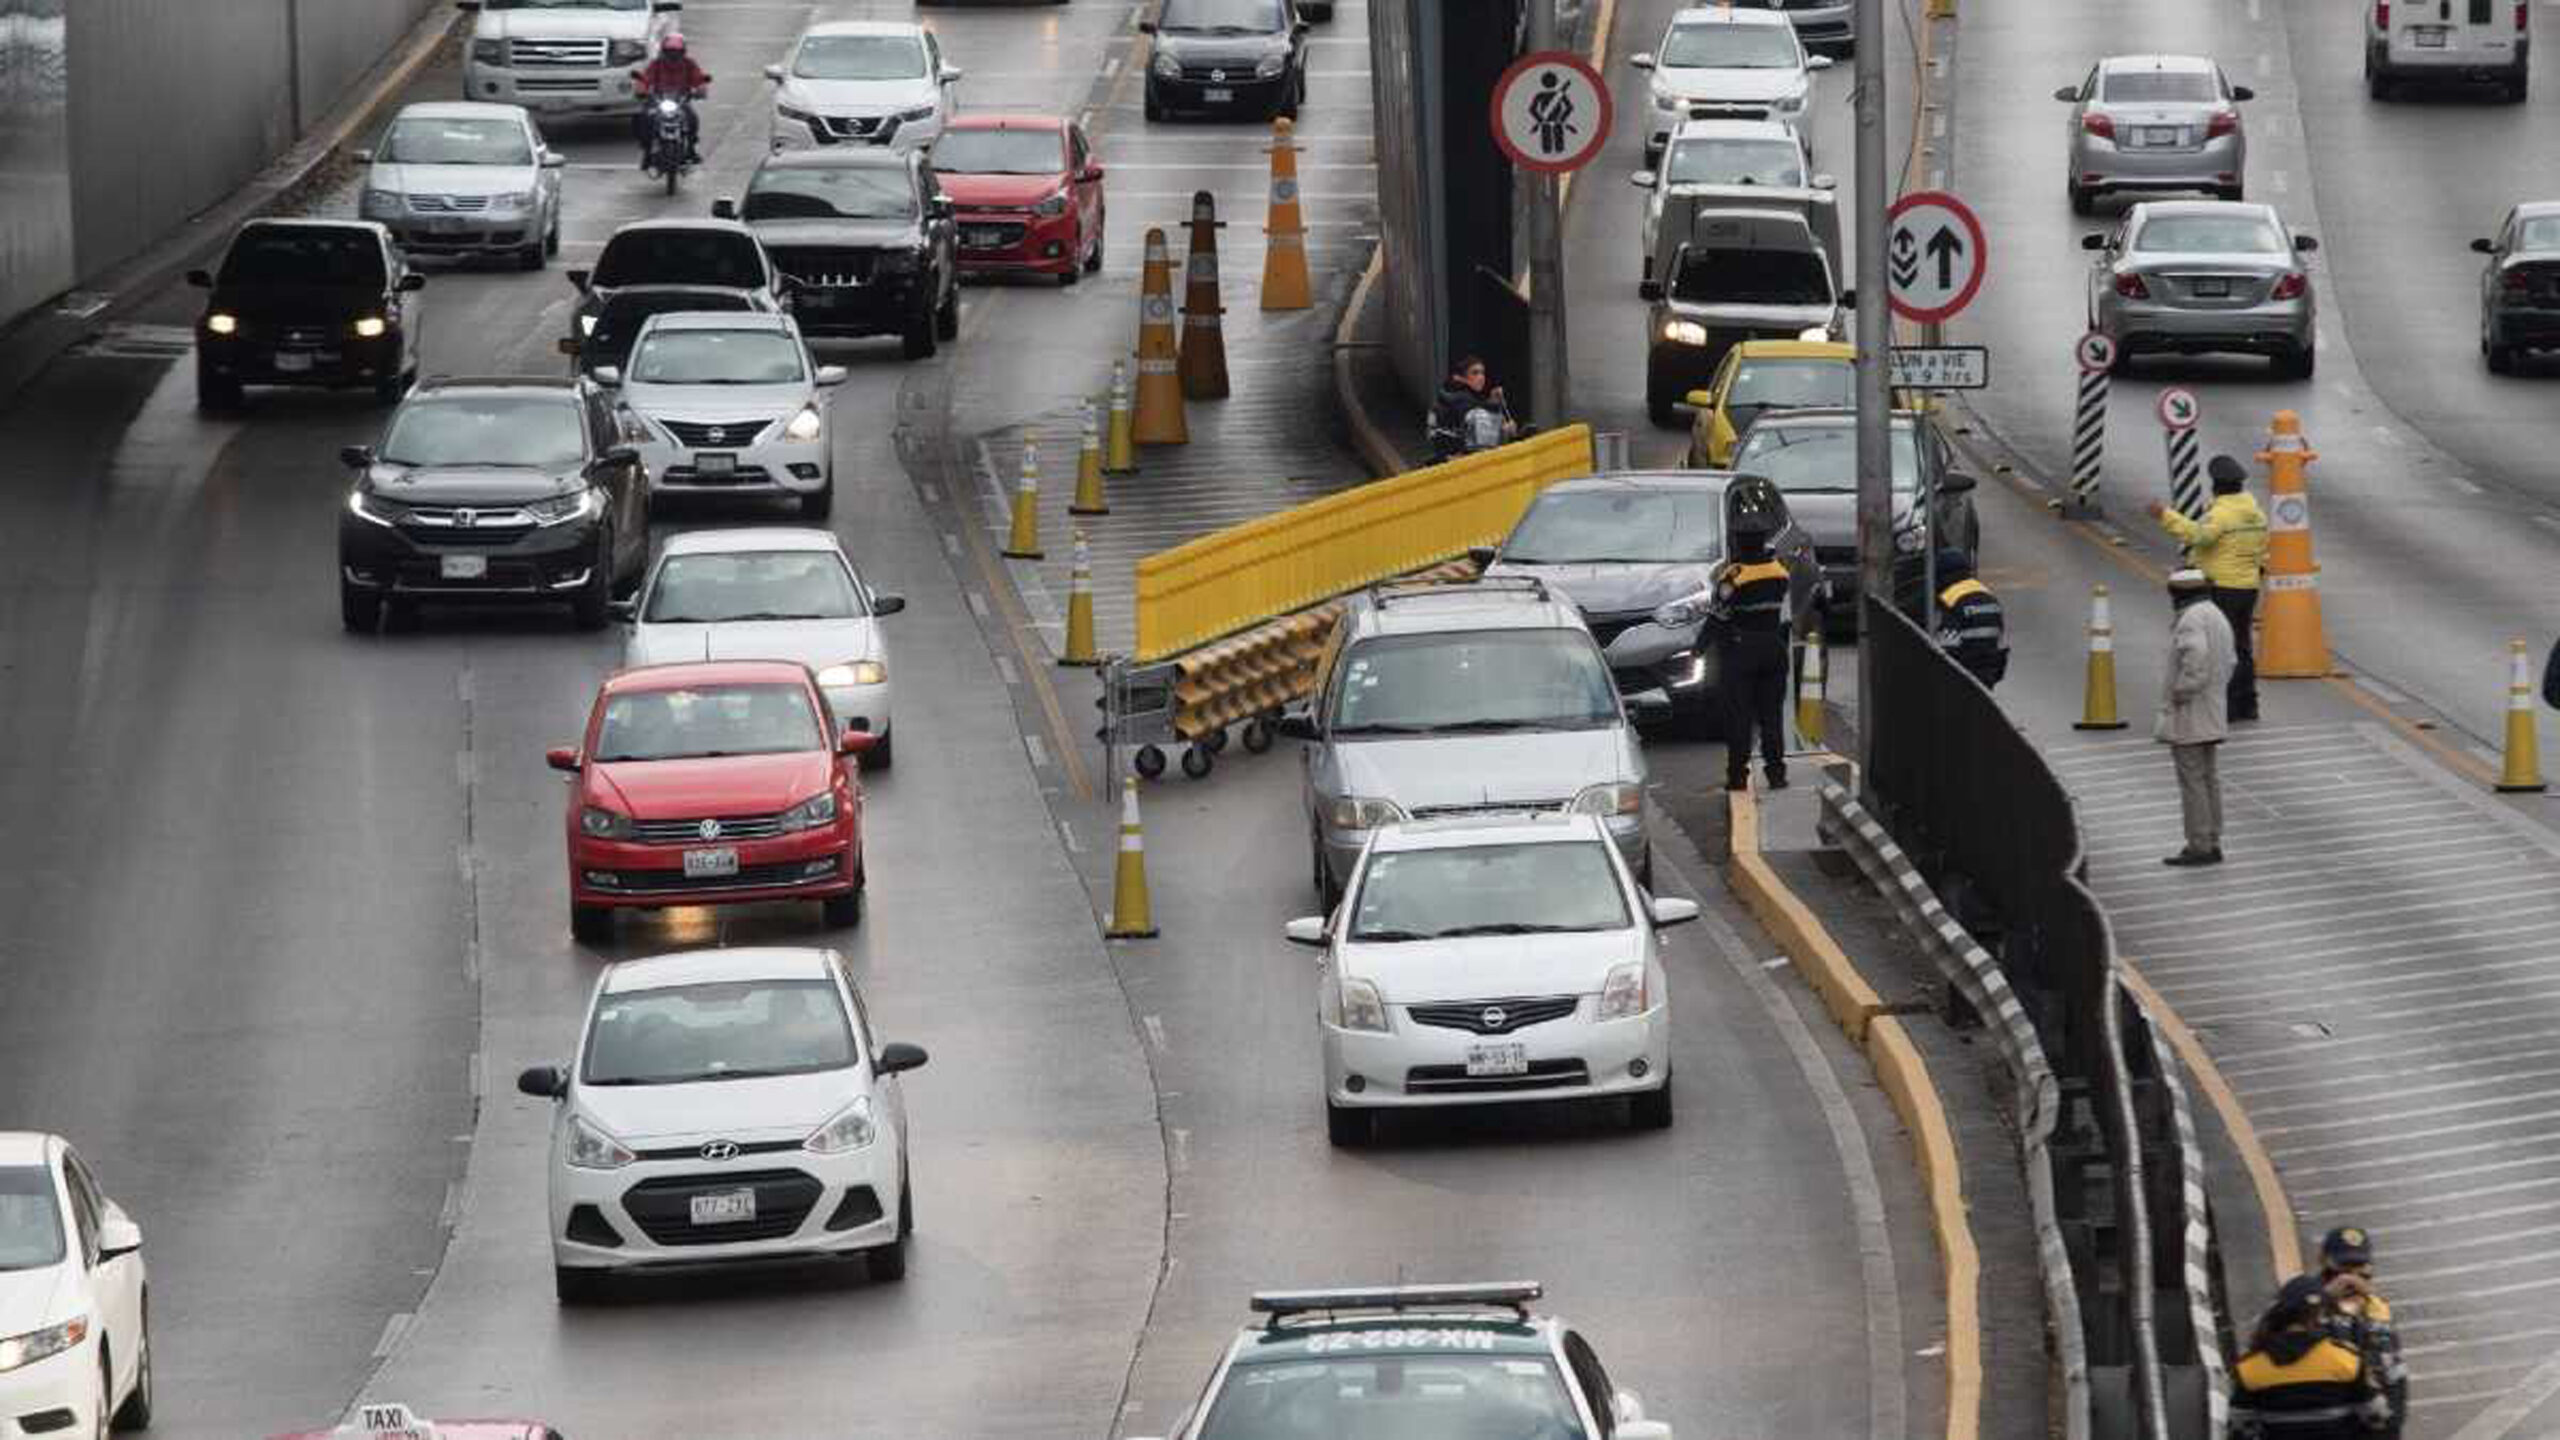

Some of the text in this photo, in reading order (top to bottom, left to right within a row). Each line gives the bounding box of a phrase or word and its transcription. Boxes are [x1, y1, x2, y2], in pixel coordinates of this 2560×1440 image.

[1928, 355, 1937, 368] a
[1943, 353, 1966, 368] VIE
[1923, 369, 1932, 383] 9
[1942, 371, 1972, 383] hrs
[364, 1407, 403, 1430] TAXI
